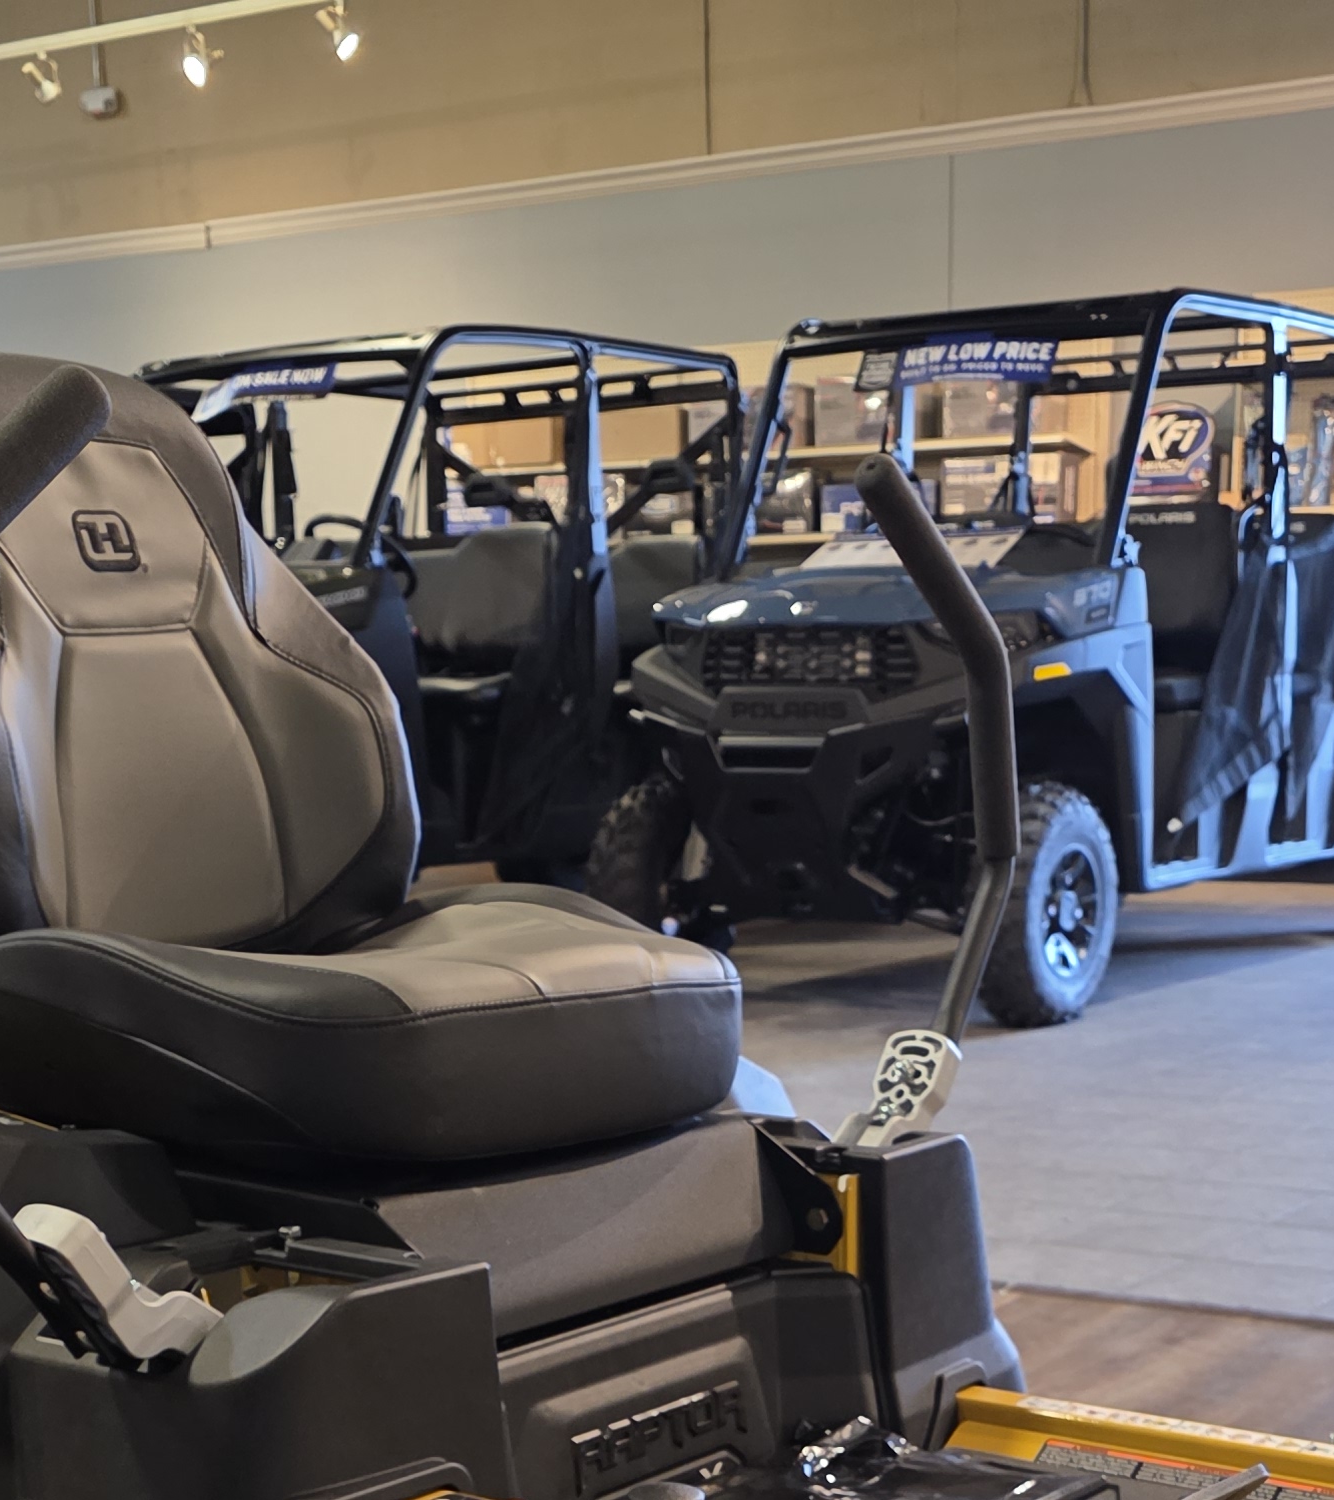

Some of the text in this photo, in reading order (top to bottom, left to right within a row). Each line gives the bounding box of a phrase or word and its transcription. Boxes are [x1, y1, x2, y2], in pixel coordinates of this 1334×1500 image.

[904, 341, 1054, 368] NEW LOW PRICE
[730, 699, 849, 721] POLARIS
[571, 1380, 748, 1497] RAPTOR
